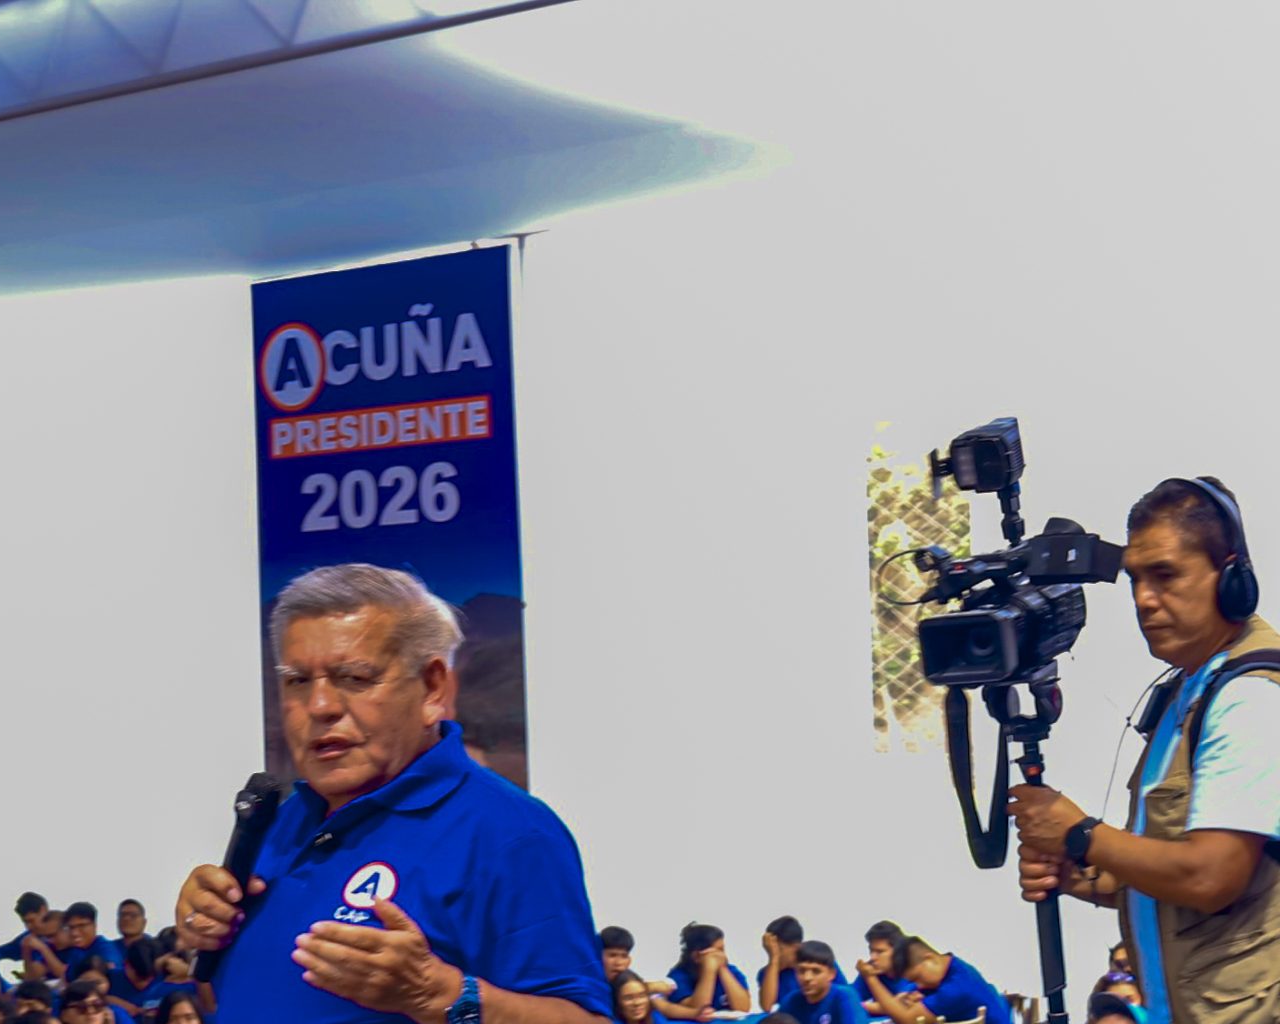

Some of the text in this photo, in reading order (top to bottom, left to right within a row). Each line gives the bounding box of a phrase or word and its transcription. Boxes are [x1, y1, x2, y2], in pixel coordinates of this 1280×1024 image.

[267, 303, 493, 396] ACUÑA
[271, 401, 488, 455] PRESIDENTE
[300, 462, 461, 532] 2026
